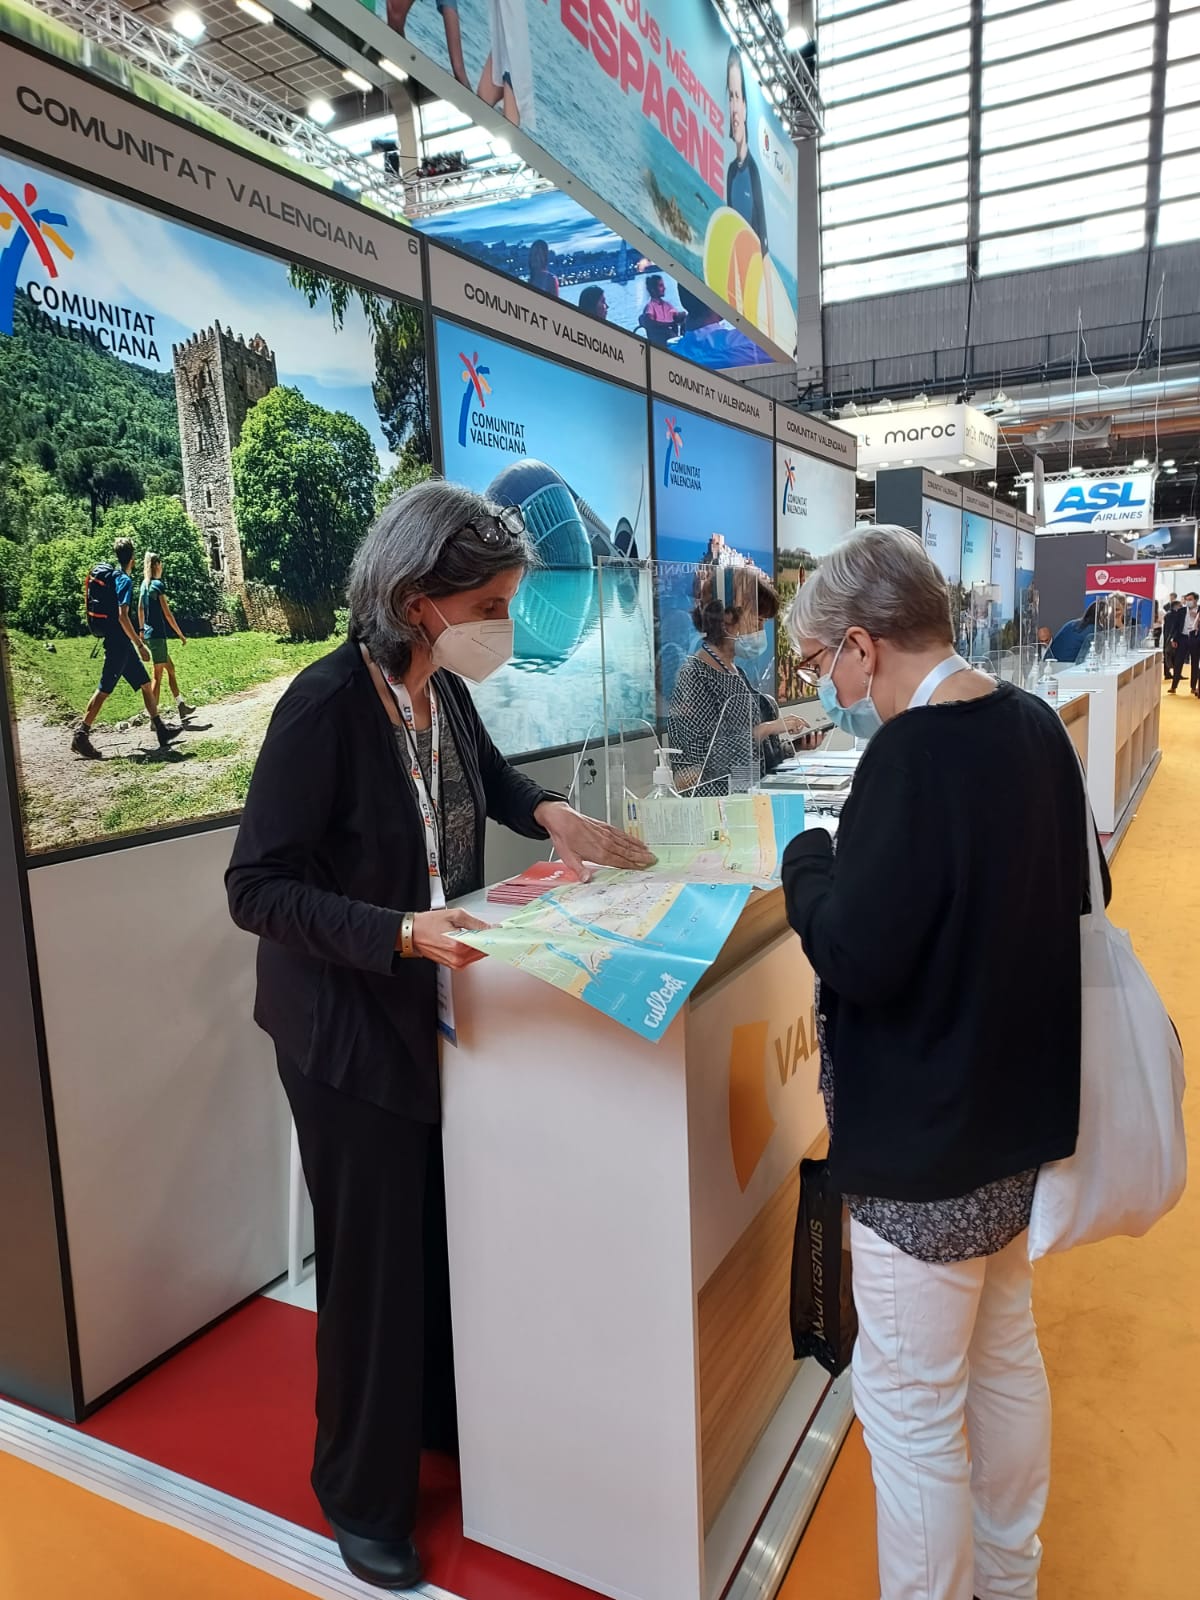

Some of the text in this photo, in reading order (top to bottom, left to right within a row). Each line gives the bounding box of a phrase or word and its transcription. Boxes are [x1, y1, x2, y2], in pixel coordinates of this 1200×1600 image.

[616, 0, 724, 138] OUS MÉRITEZ
[16, 86, 379, 261] COMUNITAT VALENCIANA
[408, 239, 419, 255] 6
[27, 281, 155, 337] COMUNITAT
[464, 282, 625, 363] COMUNITAT VALENCIANA
[26, 311, 161, 362] VALENCIANA
[639, 344, 645, 355] 7
[668, 370, 760, 419] COMUNITAT VALENCIANA
[471, 411, 525, 439] COMUNITAT
[786, 421, 817, 441] COMUNITAT
[884, 424, 956, 445] maroc
[470, 428, 527, 455] VALENCIANA
[670, 472, 701, 491] VALENCIANA
[671, 460, 701, 479] COMUNITAT
[1053, 482, 1146, 512] ASL
[1094, 511, 1144, 522] AIRLINES
